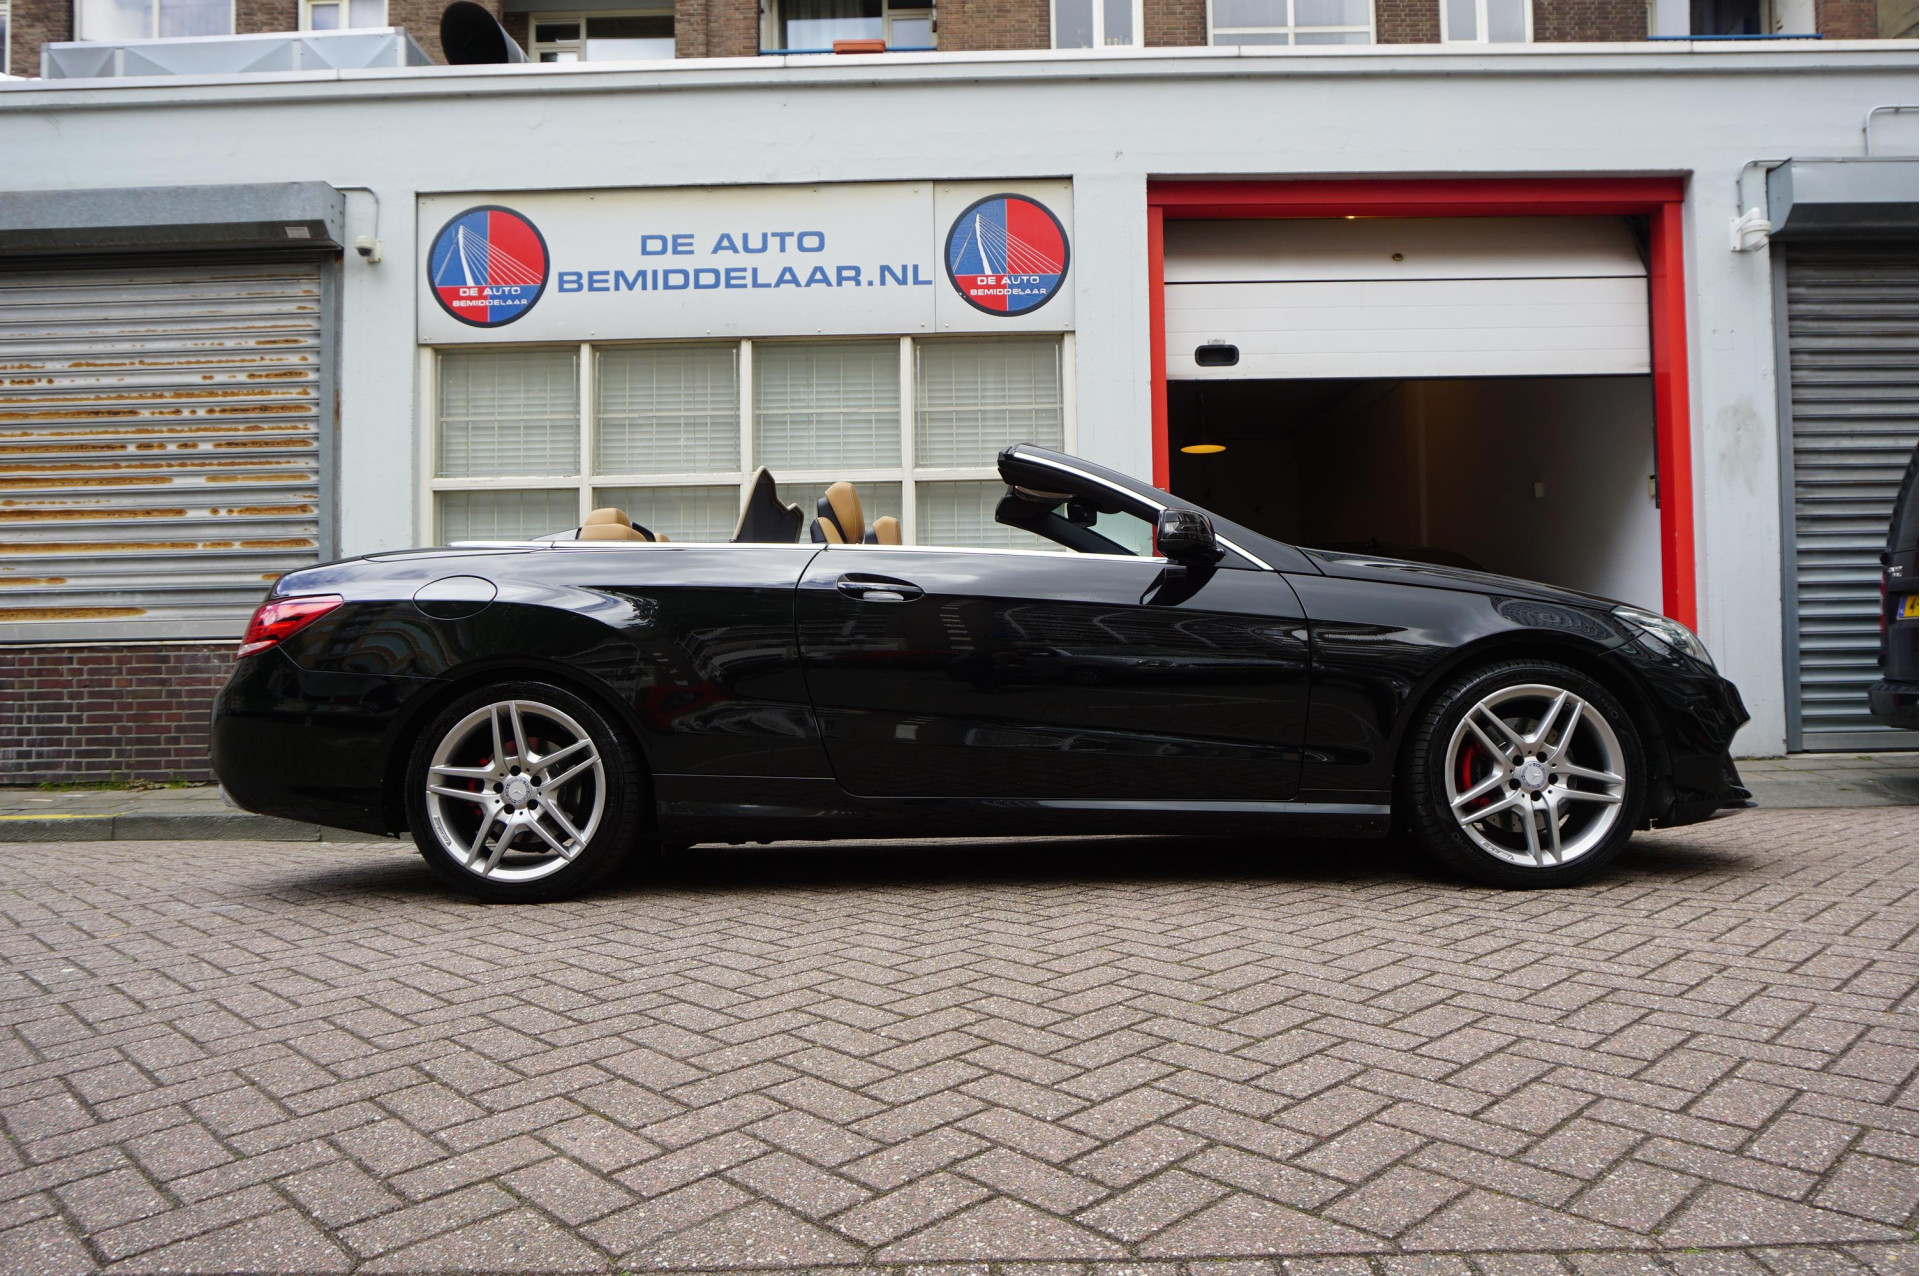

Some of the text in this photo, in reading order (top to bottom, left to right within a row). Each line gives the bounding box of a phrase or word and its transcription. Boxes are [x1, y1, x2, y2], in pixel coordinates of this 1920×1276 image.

[640, 231, 826, 256] DE AUTO
[557, 263, 933, 293] BEMIDDELAAR.NL
[977, 276, 1040, 285] DE AUTO
[459, 286, 521, 296] DE AUTO
[970, 288, 1047, 296] BEMIDDELAAR
[452, 298, 528, 307] BEMIDDELAAR
